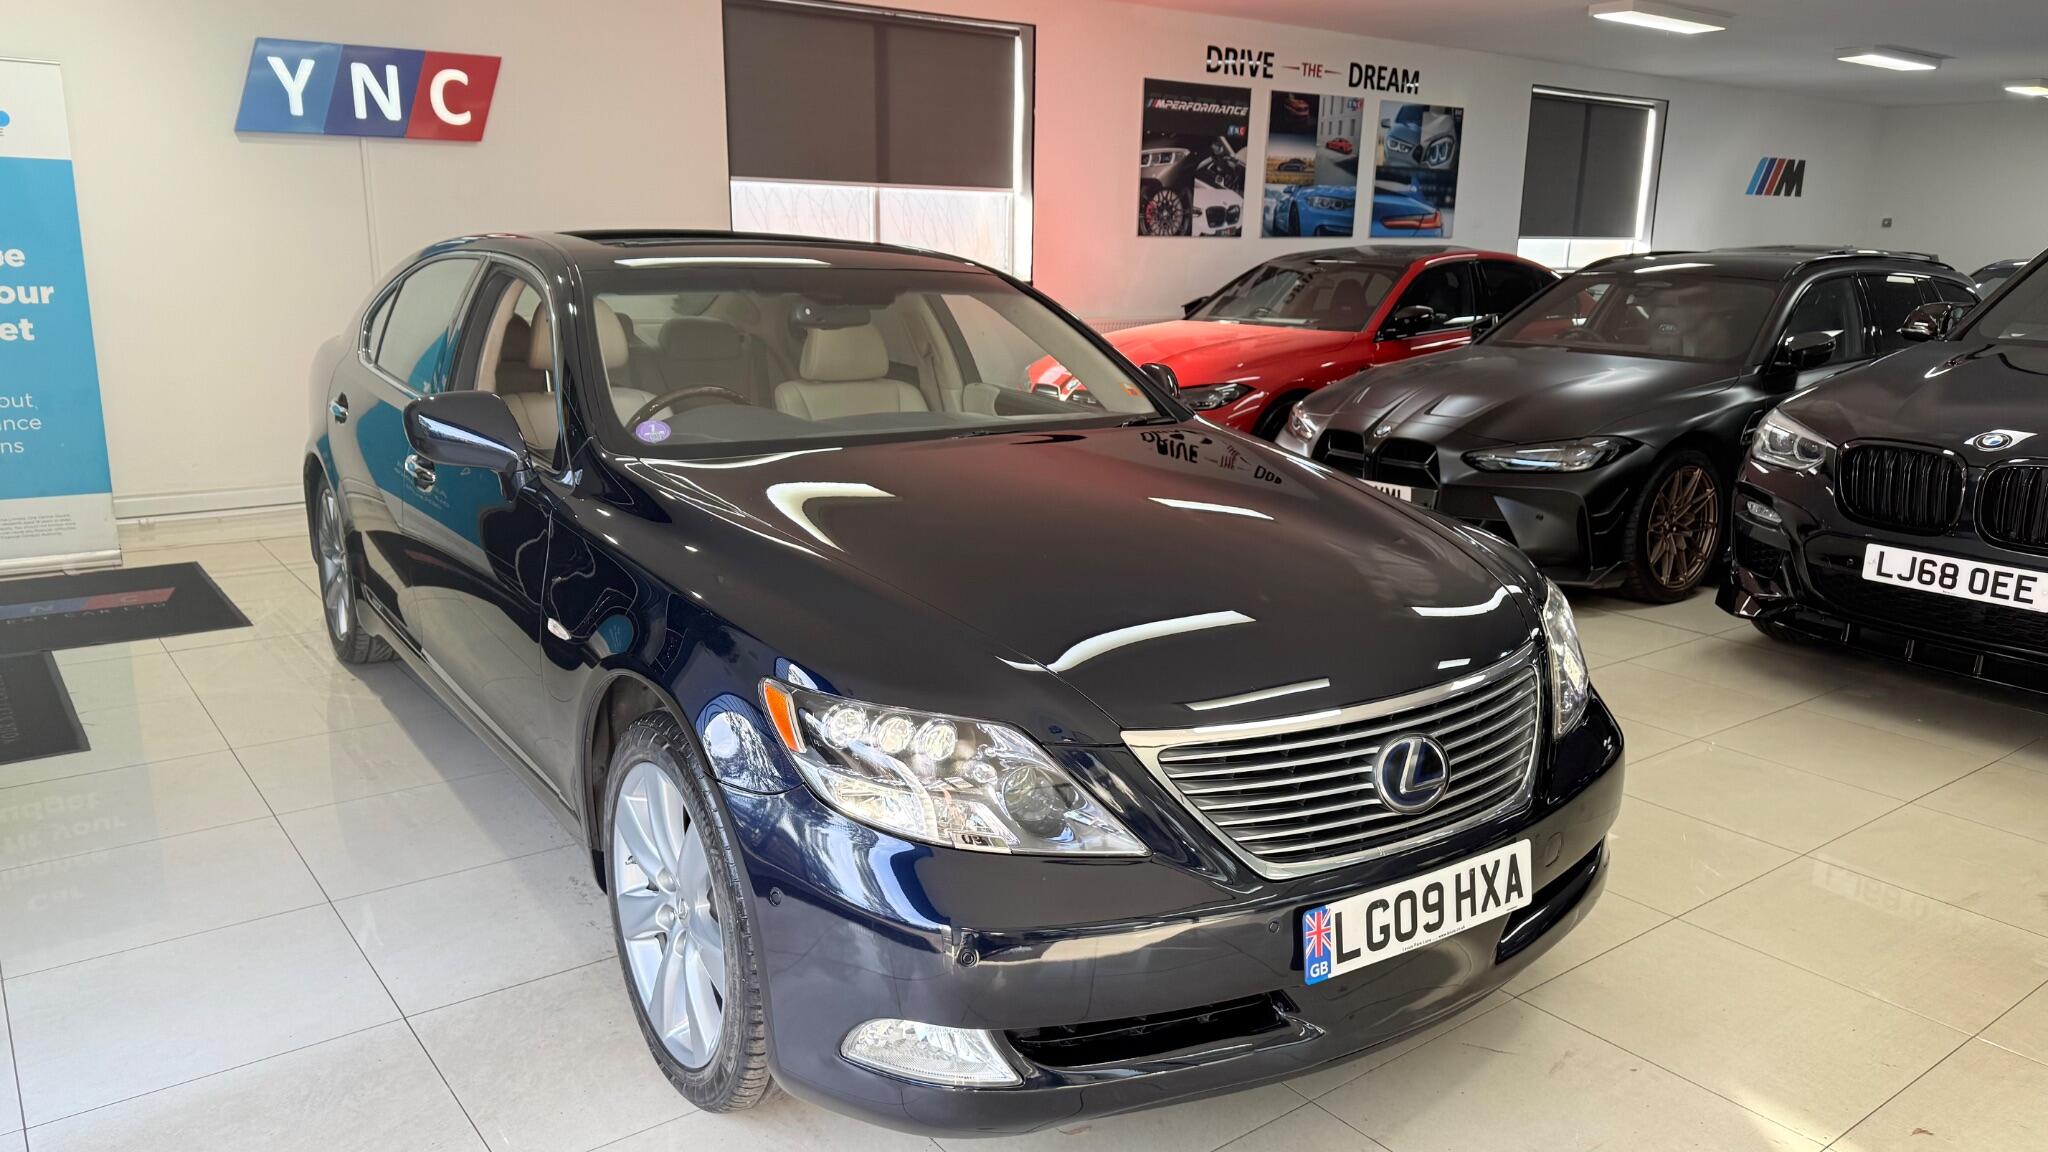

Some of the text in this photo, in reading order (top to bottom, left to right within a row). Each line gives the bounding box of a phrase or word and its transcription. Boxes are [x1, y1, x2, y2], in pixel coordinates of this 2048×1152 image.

[266, 55, 472, 126] YNC
[1206, 45, 1420, 95] DRIVE THE DREAM
[0, 418, 43, 431] nce
[1875, 551, 2038, 605] LJ68 OEE
[1334, 853, 1524, 965] LG09 HXA
[1309, 961, 1329, 978] GB
